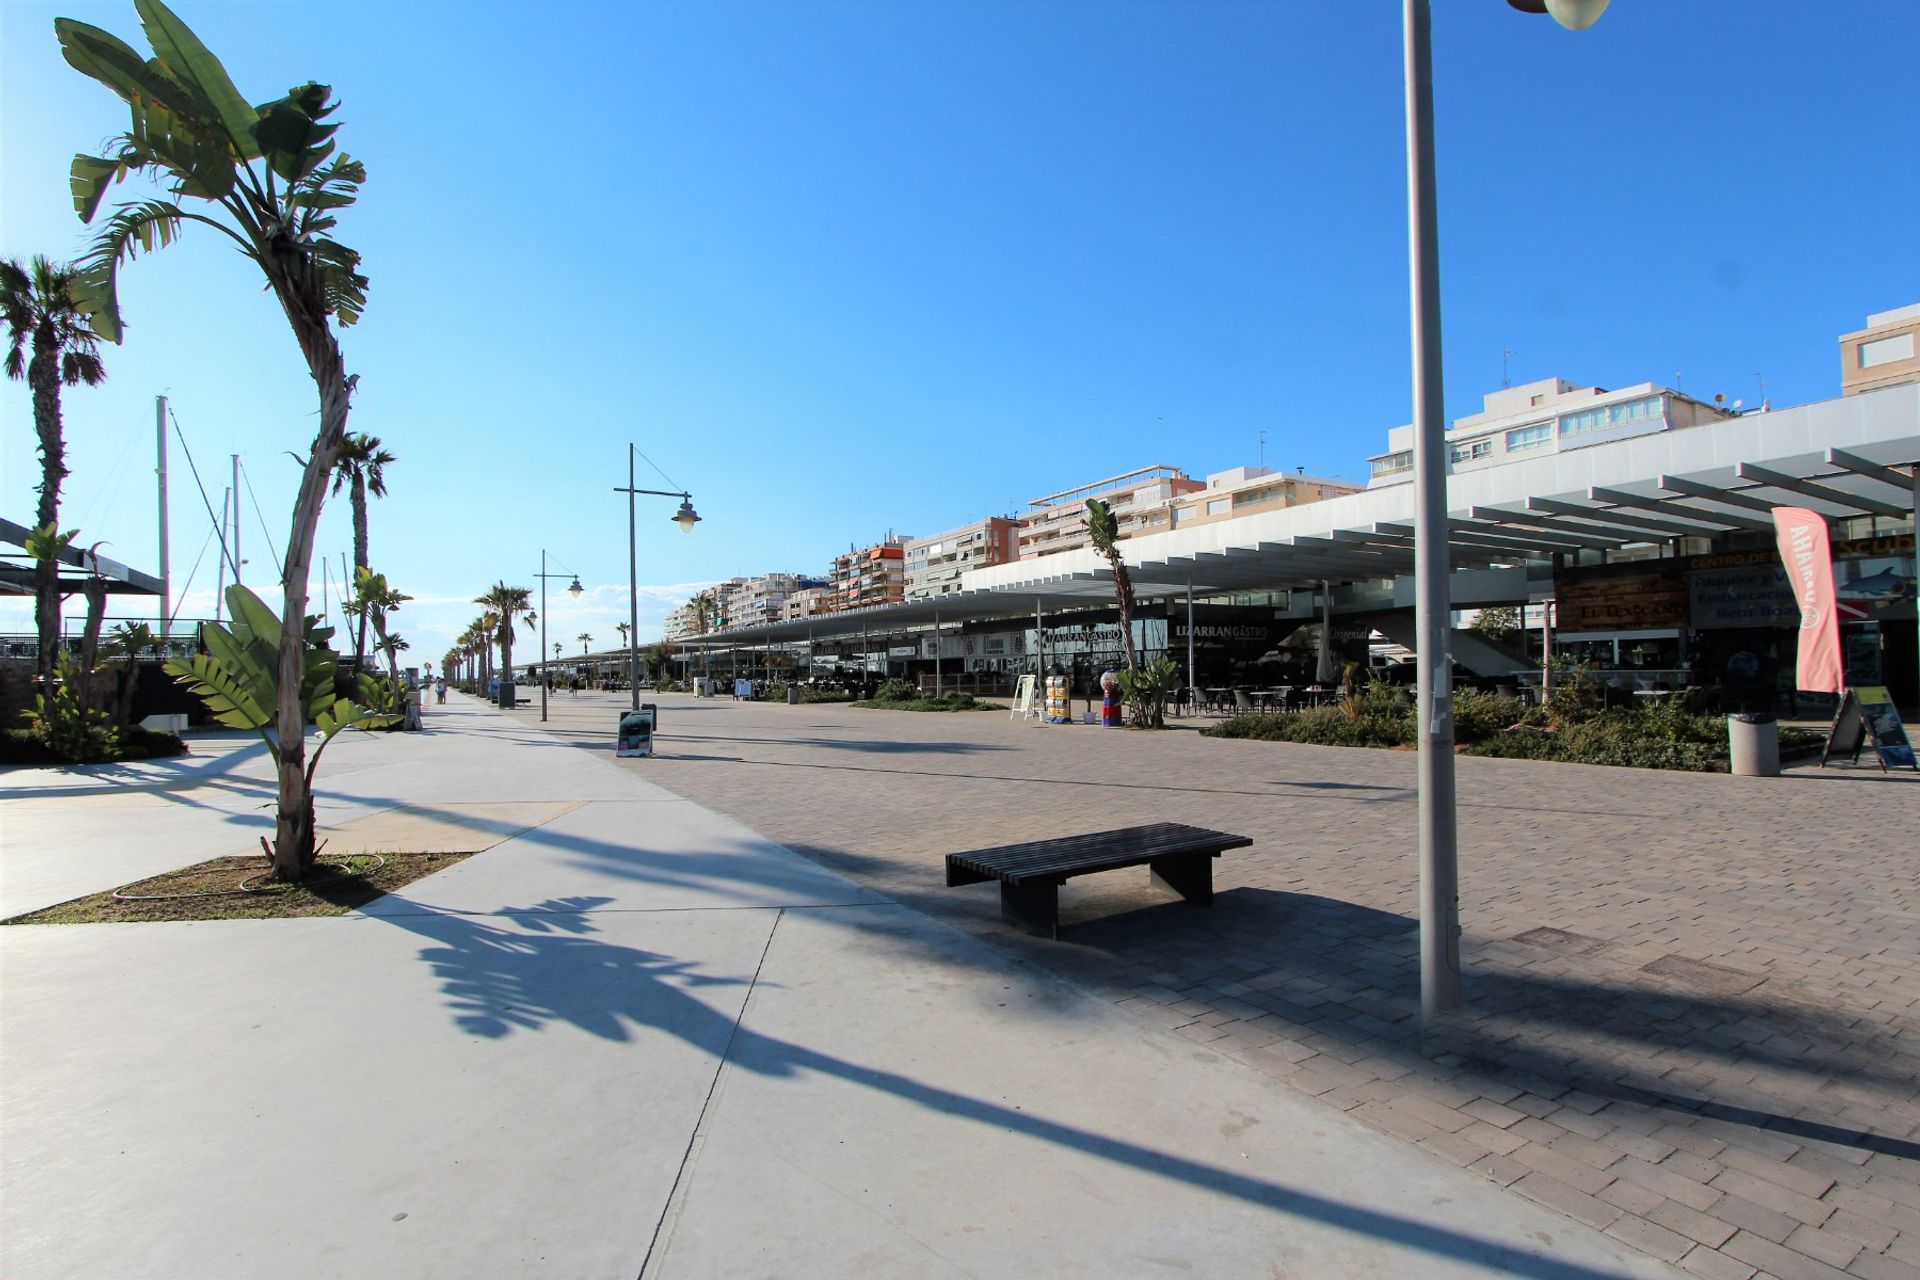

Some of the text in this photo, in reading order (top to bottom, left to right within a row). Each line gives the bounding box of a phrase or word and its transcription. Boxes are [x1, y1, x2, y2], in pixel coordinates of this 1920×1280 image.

[1838, 535, 1914, 554] Scub
[1691, 554, 1745, 568] CENTRO
[1750, 553, 1770, 564] DE
[1695, 573, 1755, 588] Alquiler
[1698, 590, 1791, 604] Embarcacio
[1717, 607, 1753, 619] Rent
[1044, 631, 1086, 644] IZARRAN
